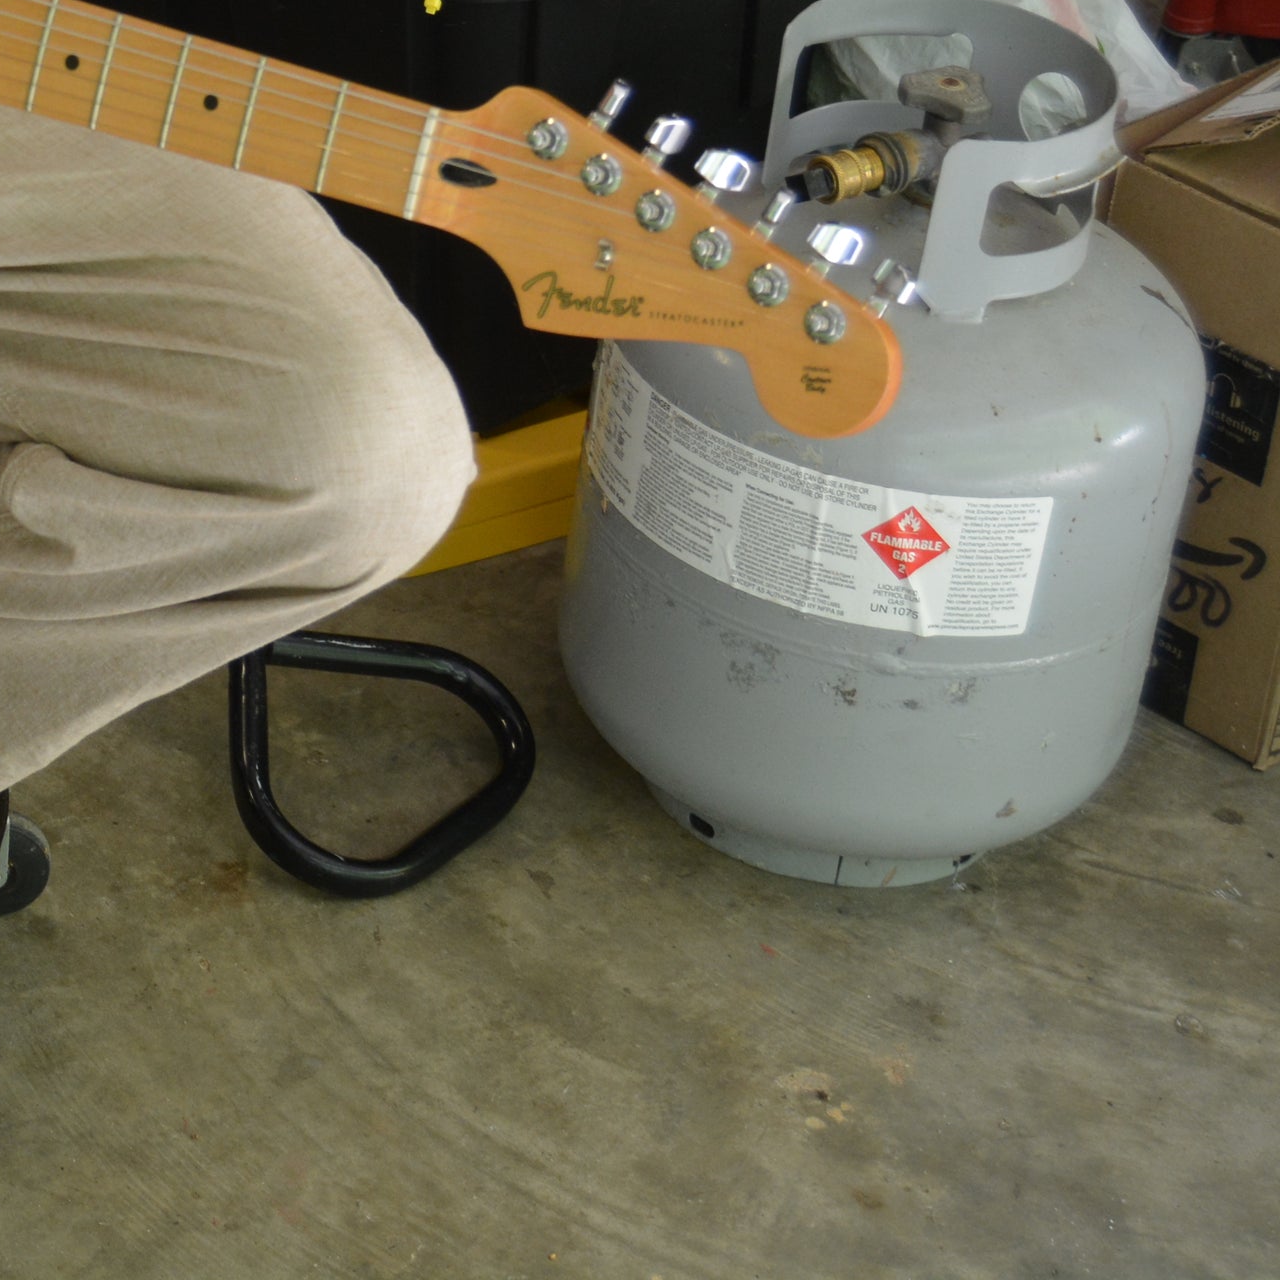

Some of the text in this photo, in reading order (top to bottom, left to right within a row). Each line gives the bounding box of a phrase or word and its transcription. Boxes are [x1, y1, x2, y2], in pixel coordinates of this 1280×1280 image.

[522, 270, 645, 319] Fender
[803, 471, 817, 482] CAN
[859, 487, 869, 495] OR
[788, 482, 800, 492] NOT
[801, 487, 814, 498] USE
[824, 493, 845, 506] STORE
[846, 500, 878, 512] CYLINDER
[846, 491, 861, 500] THIS
[870, 532, 943, 552] FLAMMABLE
[892, 550, 917, 563] GAS
[898, 563, 906, 574] 2
[872, 589, 921, 603] PETROLEUM
[877, 583, 918, 596] LIQUEFIED
[887, 598, 905, 606] GAS
[870, 603, 919, 620] UN 1075
